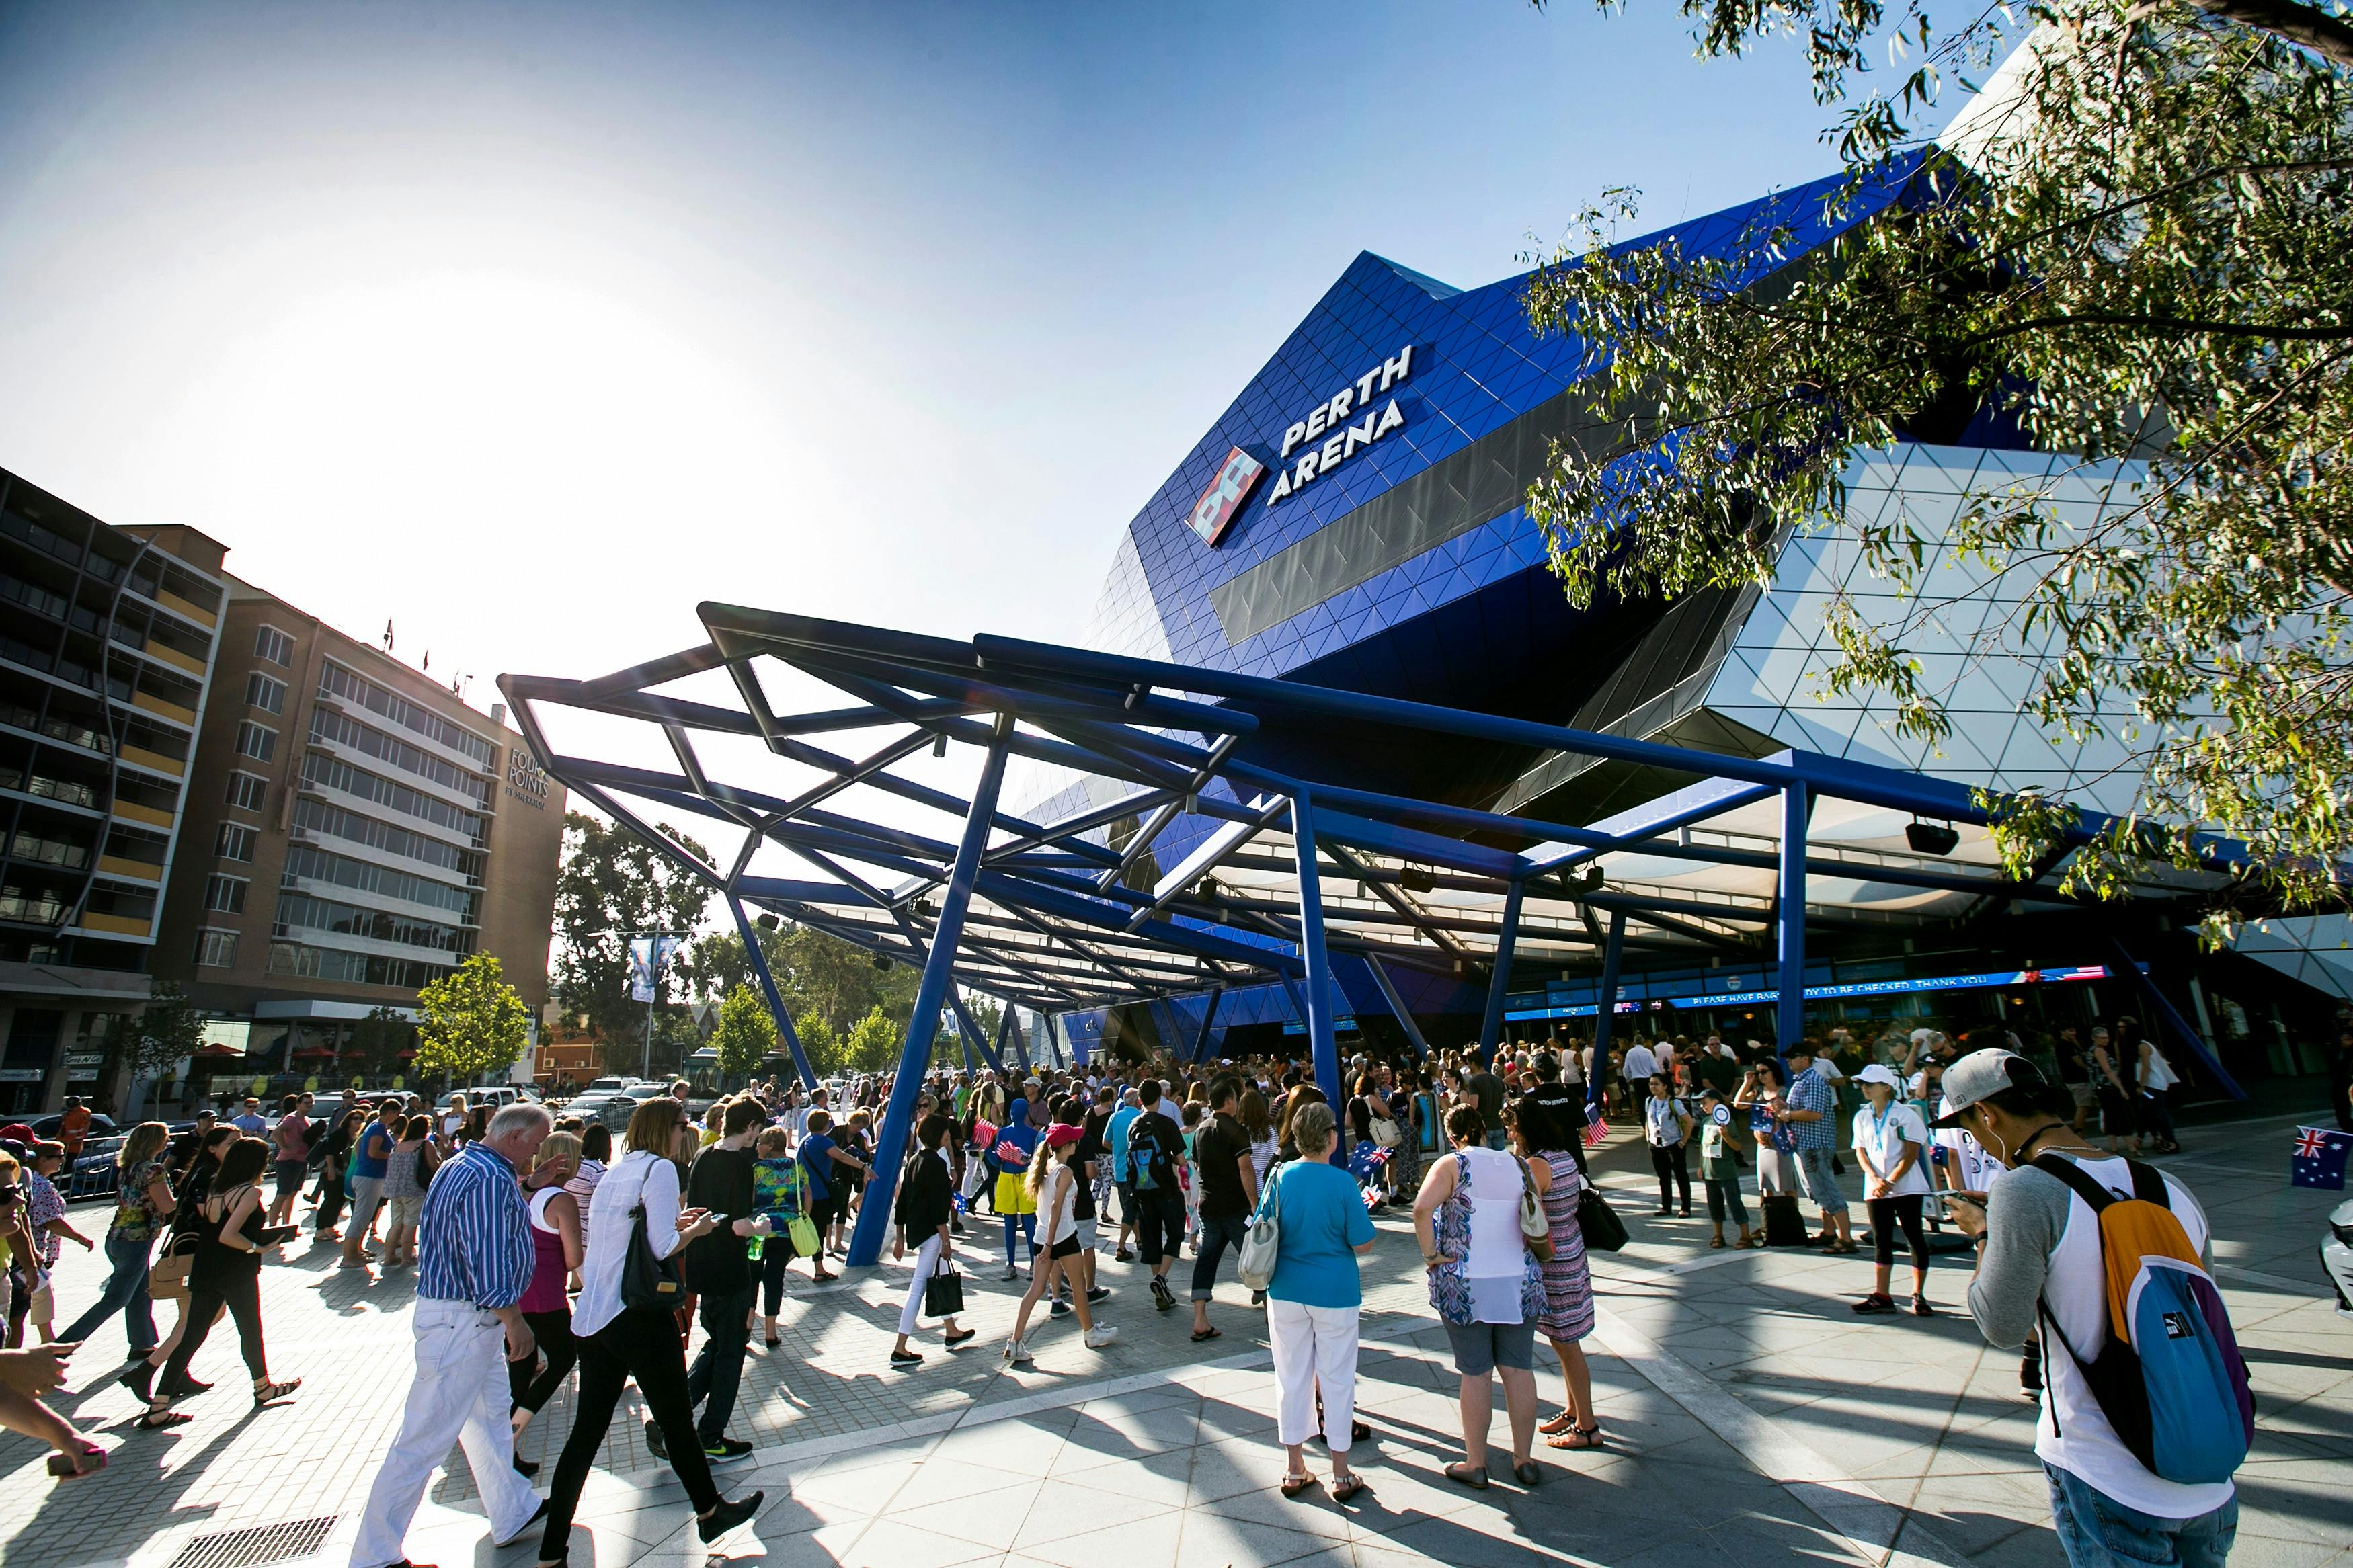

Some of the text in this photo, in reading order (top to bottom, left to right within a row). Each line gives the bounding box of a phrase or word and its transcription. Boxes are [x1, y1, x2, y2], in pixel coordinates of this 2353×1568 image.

[1280, 343, 1413, 458] PERTH
[1267, 398, 1405, 507] ARENA
[509, 766, 549, 798] POINTS
[515, 790, 546, 811] SHERATON
[1693, 995, 1726, 1005] PLEASE
[1730, 993, 1754, 1003] HAVE
[1823, 987, 1837, 995] TO
[1840, 985, 1853, 994] BE
[1915, 978, 1957, 988] THANK
[1960, 975, 1987, 985] YOU
